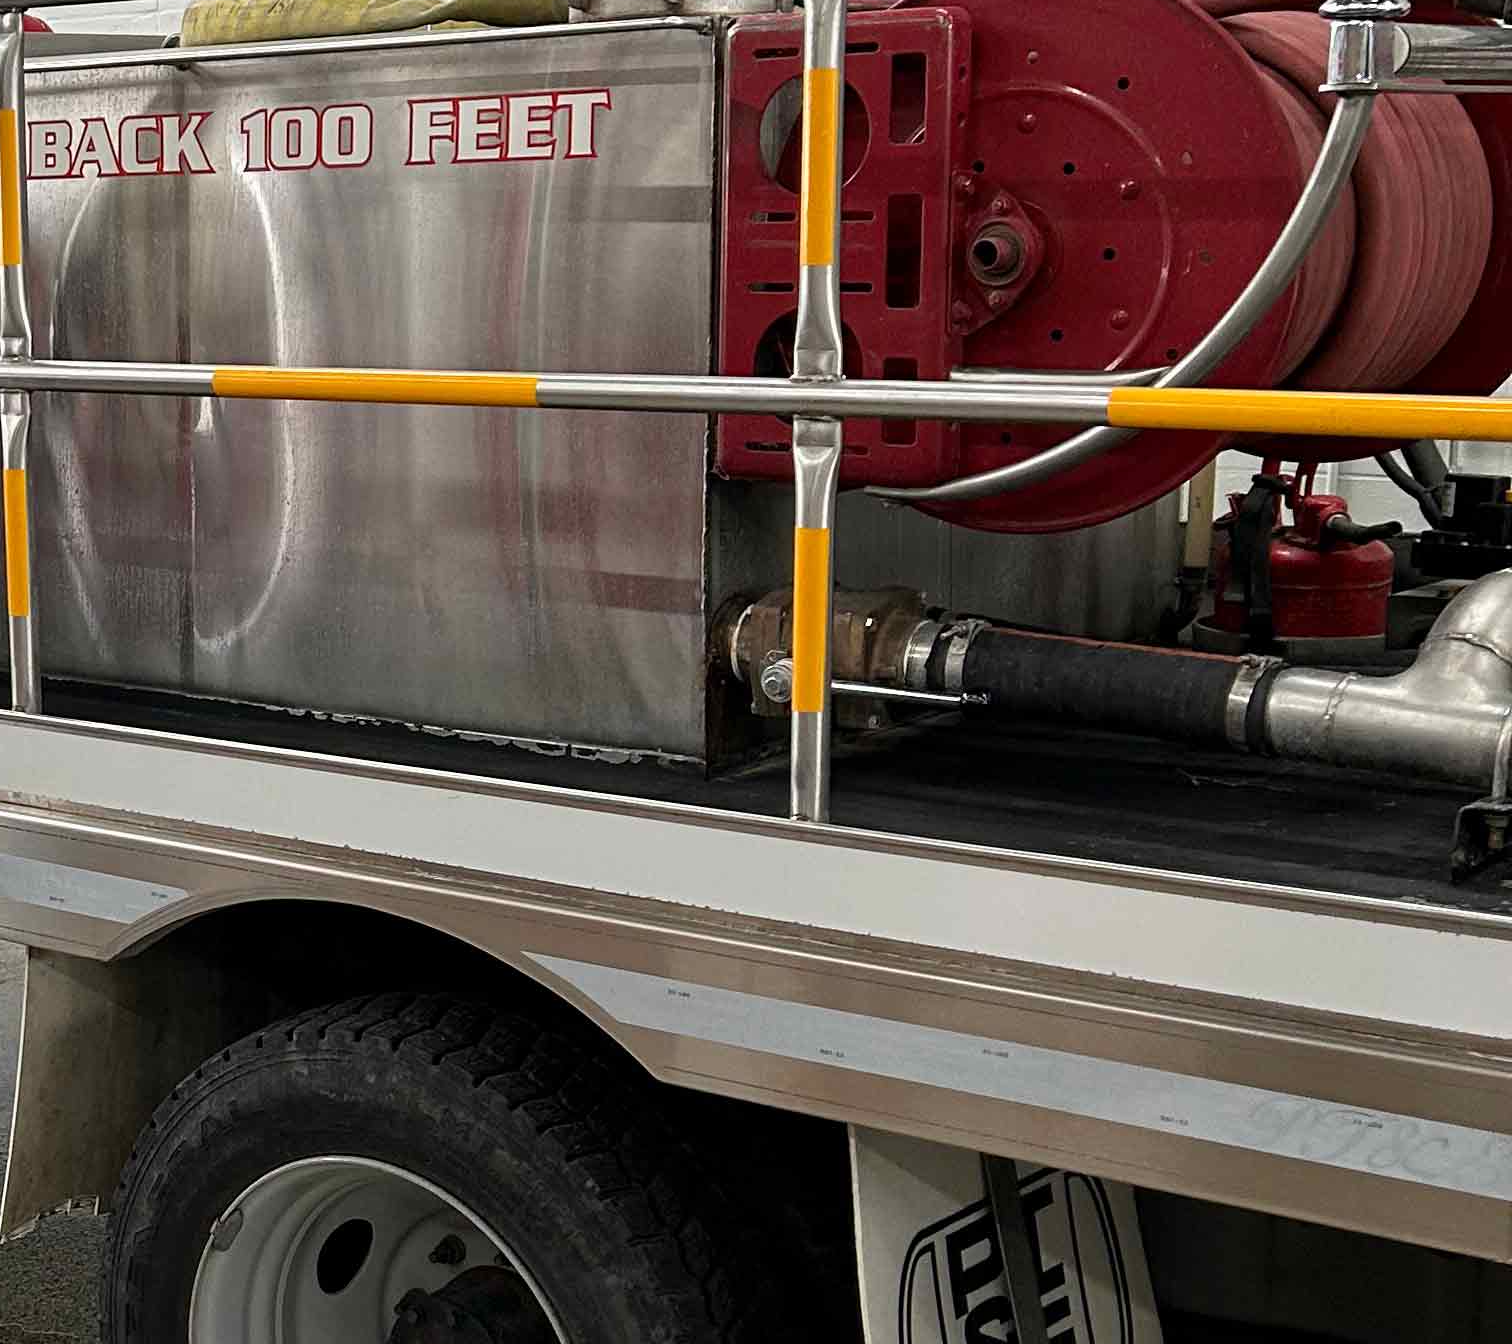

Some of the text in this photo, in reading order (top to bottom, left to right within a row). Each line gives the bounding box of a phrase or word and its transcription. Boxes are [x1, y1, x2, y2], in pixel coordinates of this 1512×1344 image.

[26, 111, 216, 181] BACK
[241, 103, 374, 173] 100
[405, 88, 612, 166] FEET
